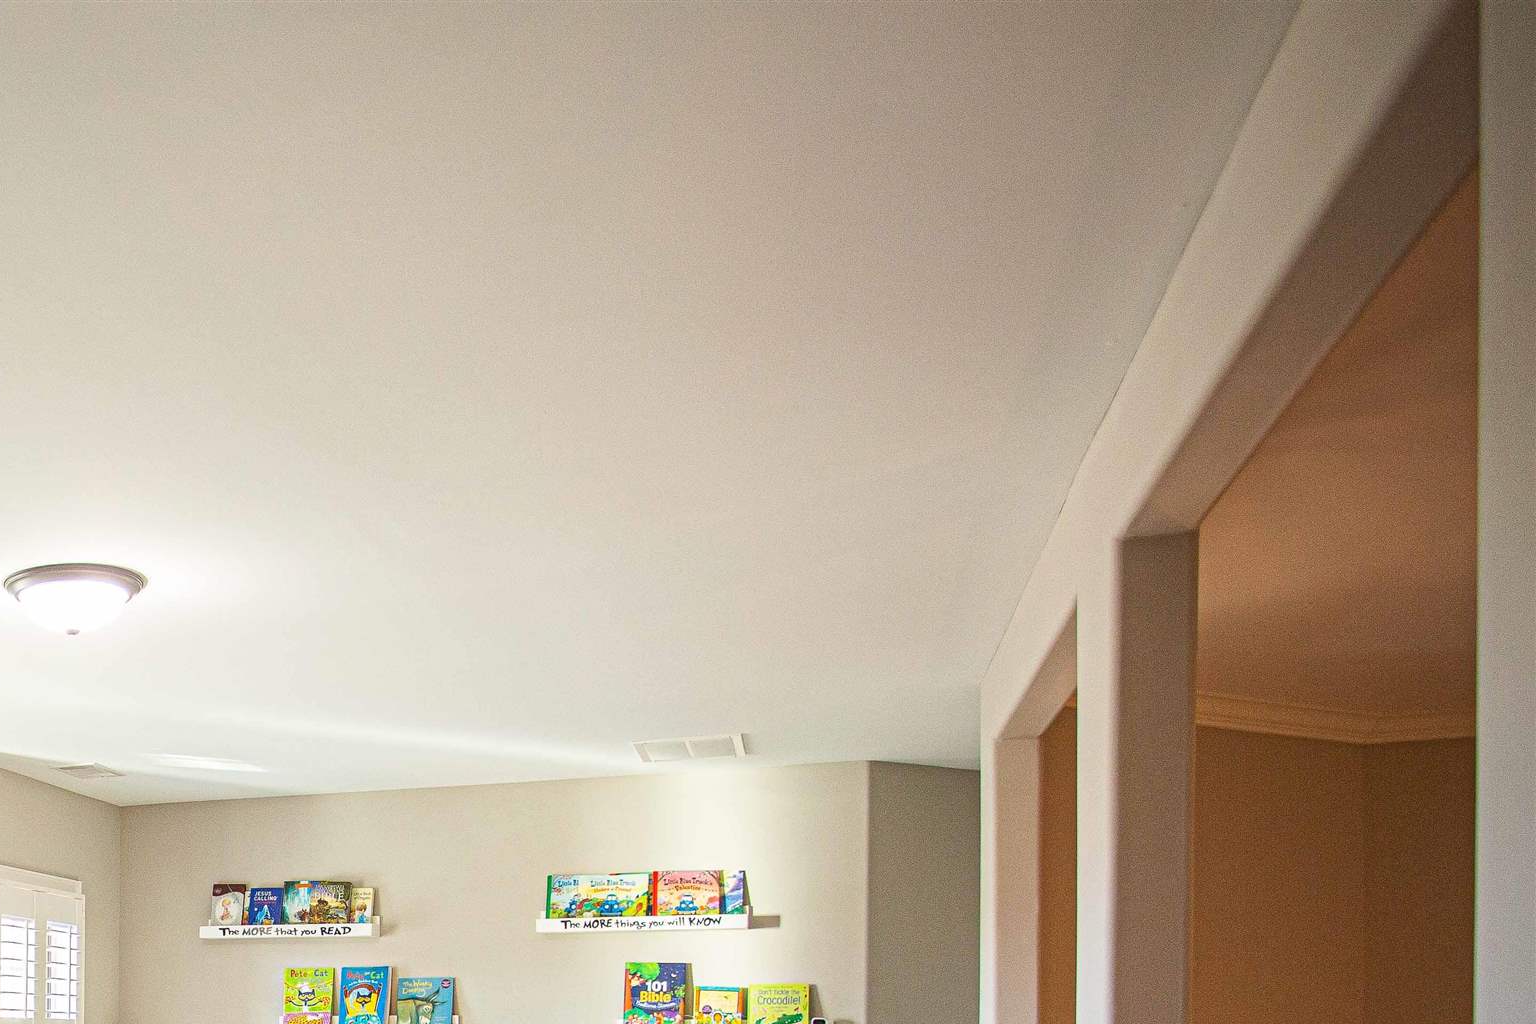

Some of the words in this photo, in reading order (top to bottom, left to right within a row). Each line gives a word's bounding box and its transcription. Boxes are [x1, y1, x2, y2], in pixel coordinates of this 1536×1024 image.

[560, 920, 580, 929] The
[583, 918, 612, 929] MORE
[615, 918, 646, 930] things
[648, 920, 664, 928] you
[667, 917, 685, 926] will
[688, 916, 722, 927] KNOW
[219, 927, 239, 937] The
[242, 926, 272, 936] MORE
[274, 926, 298, 936] that
[300, 928, 317, 937] you
[320, 926, 352, 936] READ
[314, 968, 328, 977] Cat
[645, 980, 668, 992] 101
[639, 990, 672, 1003] Bible
